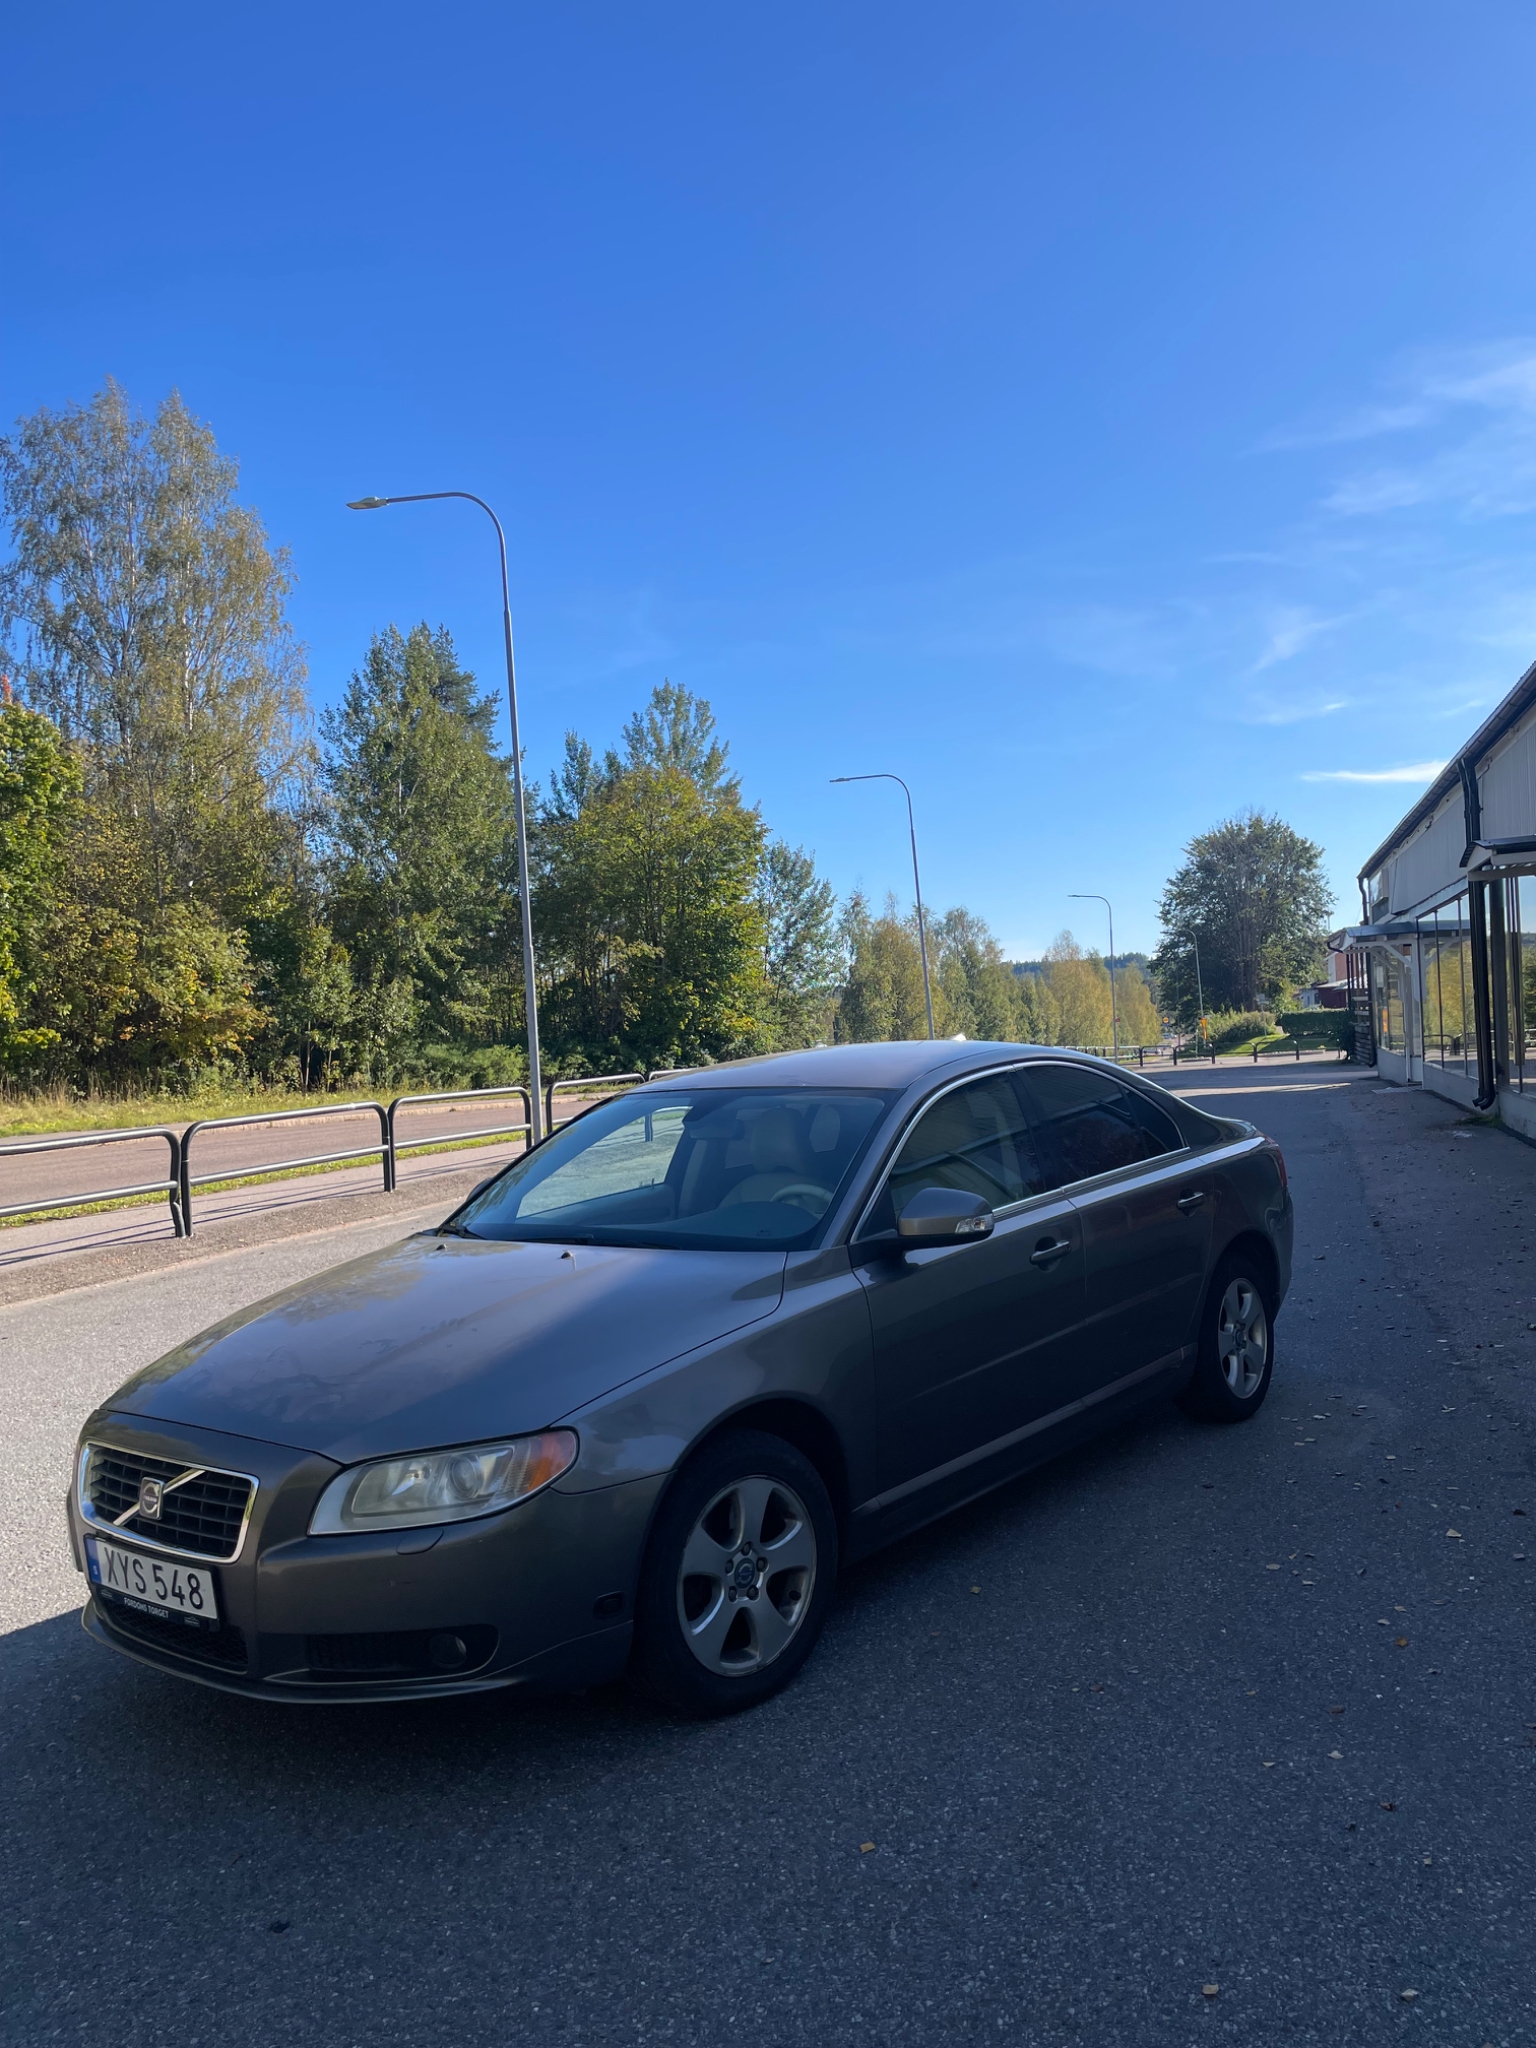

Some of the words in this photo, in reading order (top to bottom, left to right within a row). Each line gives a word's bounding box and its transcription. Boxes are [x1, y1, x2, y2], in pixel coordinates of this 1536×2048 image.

[104, 1547, 147, 1594] XYS
[152, 1563, 204, 1610] 548
[123, 1597, 148, 1612] FORDONS
[148, 1605, 169, 1619] TORGET
